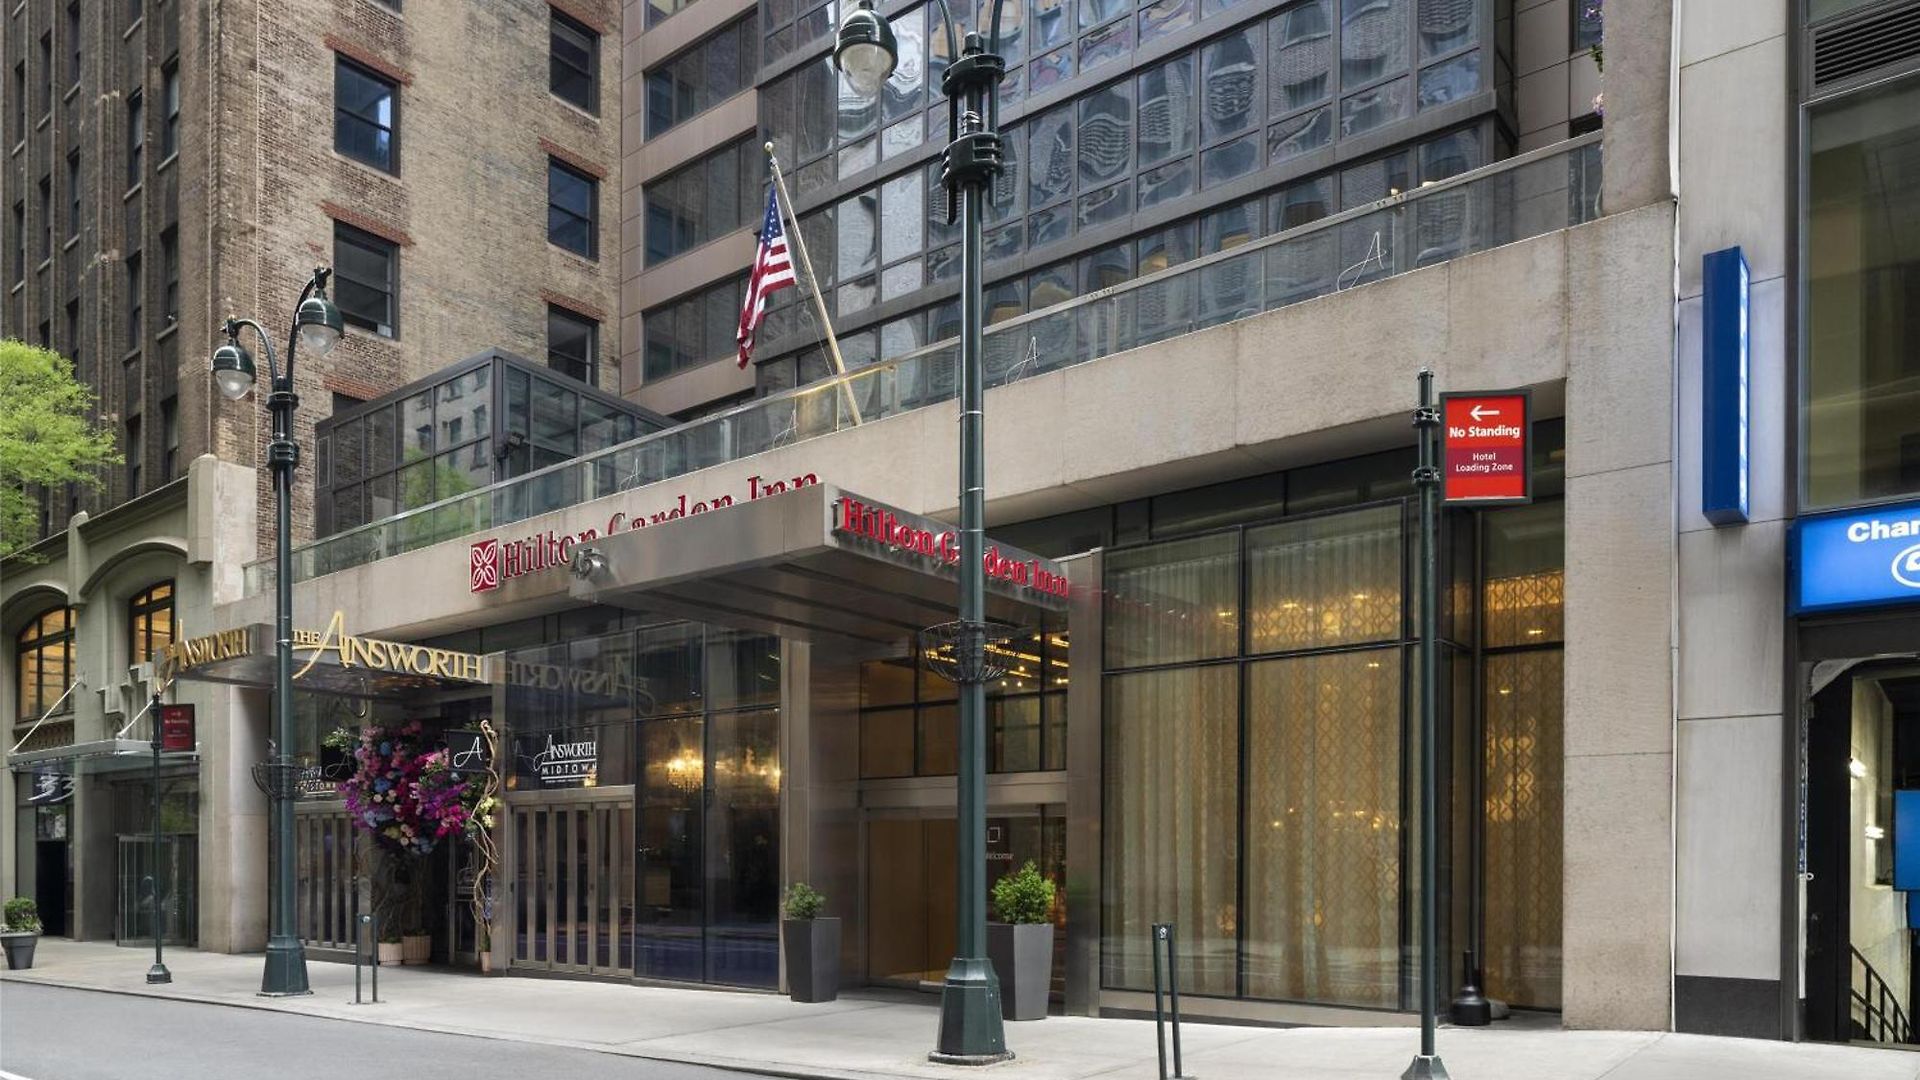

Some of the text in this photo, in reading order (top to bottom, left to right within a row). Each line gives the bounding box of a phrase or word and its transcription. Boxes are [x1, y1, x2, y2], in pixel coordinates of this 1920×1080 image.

[1449, 425, 1521, 439] No Standing
[1456, 462, 1514, 473] Loading Zone
[1472, 453, 1496, 461] Hotel
[838, 496, 1069, 598] Hilton Gden Inn
[292, 610, 483, 681] THE AINSWORTH
[453, 736, 484, 768] A
[533, 734, 597, 772] AINSWORTH
[541, 762, 598, 776] MIDTOWN
